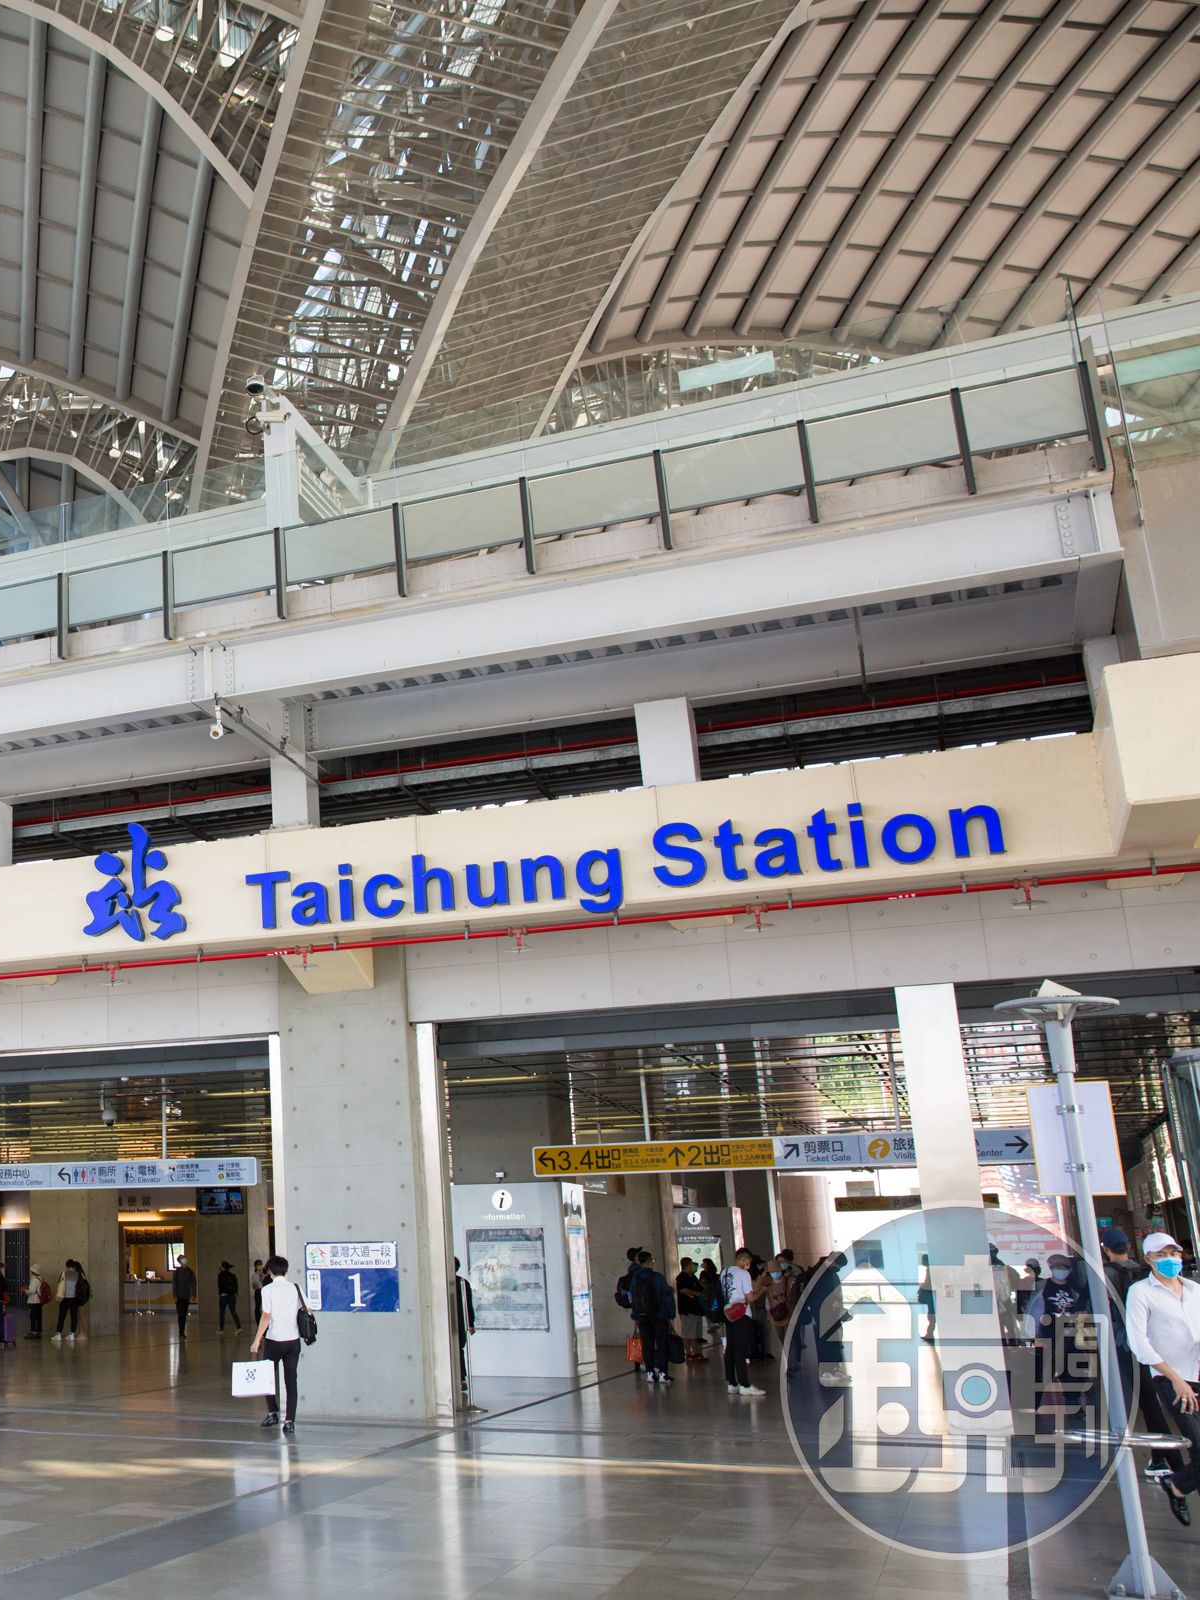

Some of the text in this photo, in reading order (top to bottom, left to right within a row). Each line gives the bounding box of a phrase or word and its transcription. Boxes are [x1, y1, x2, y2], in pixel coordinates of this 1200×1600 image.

[245, 801, 1007, 915] Taichung Station
[804, 1140, 844, 1154] 剪票口
[831, 1154, 851, 1162] Gate
[98, 1166, 117, 1177] 廁所
[138, 1164, 157, 1176] 電梯
[329, 1245, 391, 1258] 臺灣大道一段
[347, 1272, 367, 1307] 1
